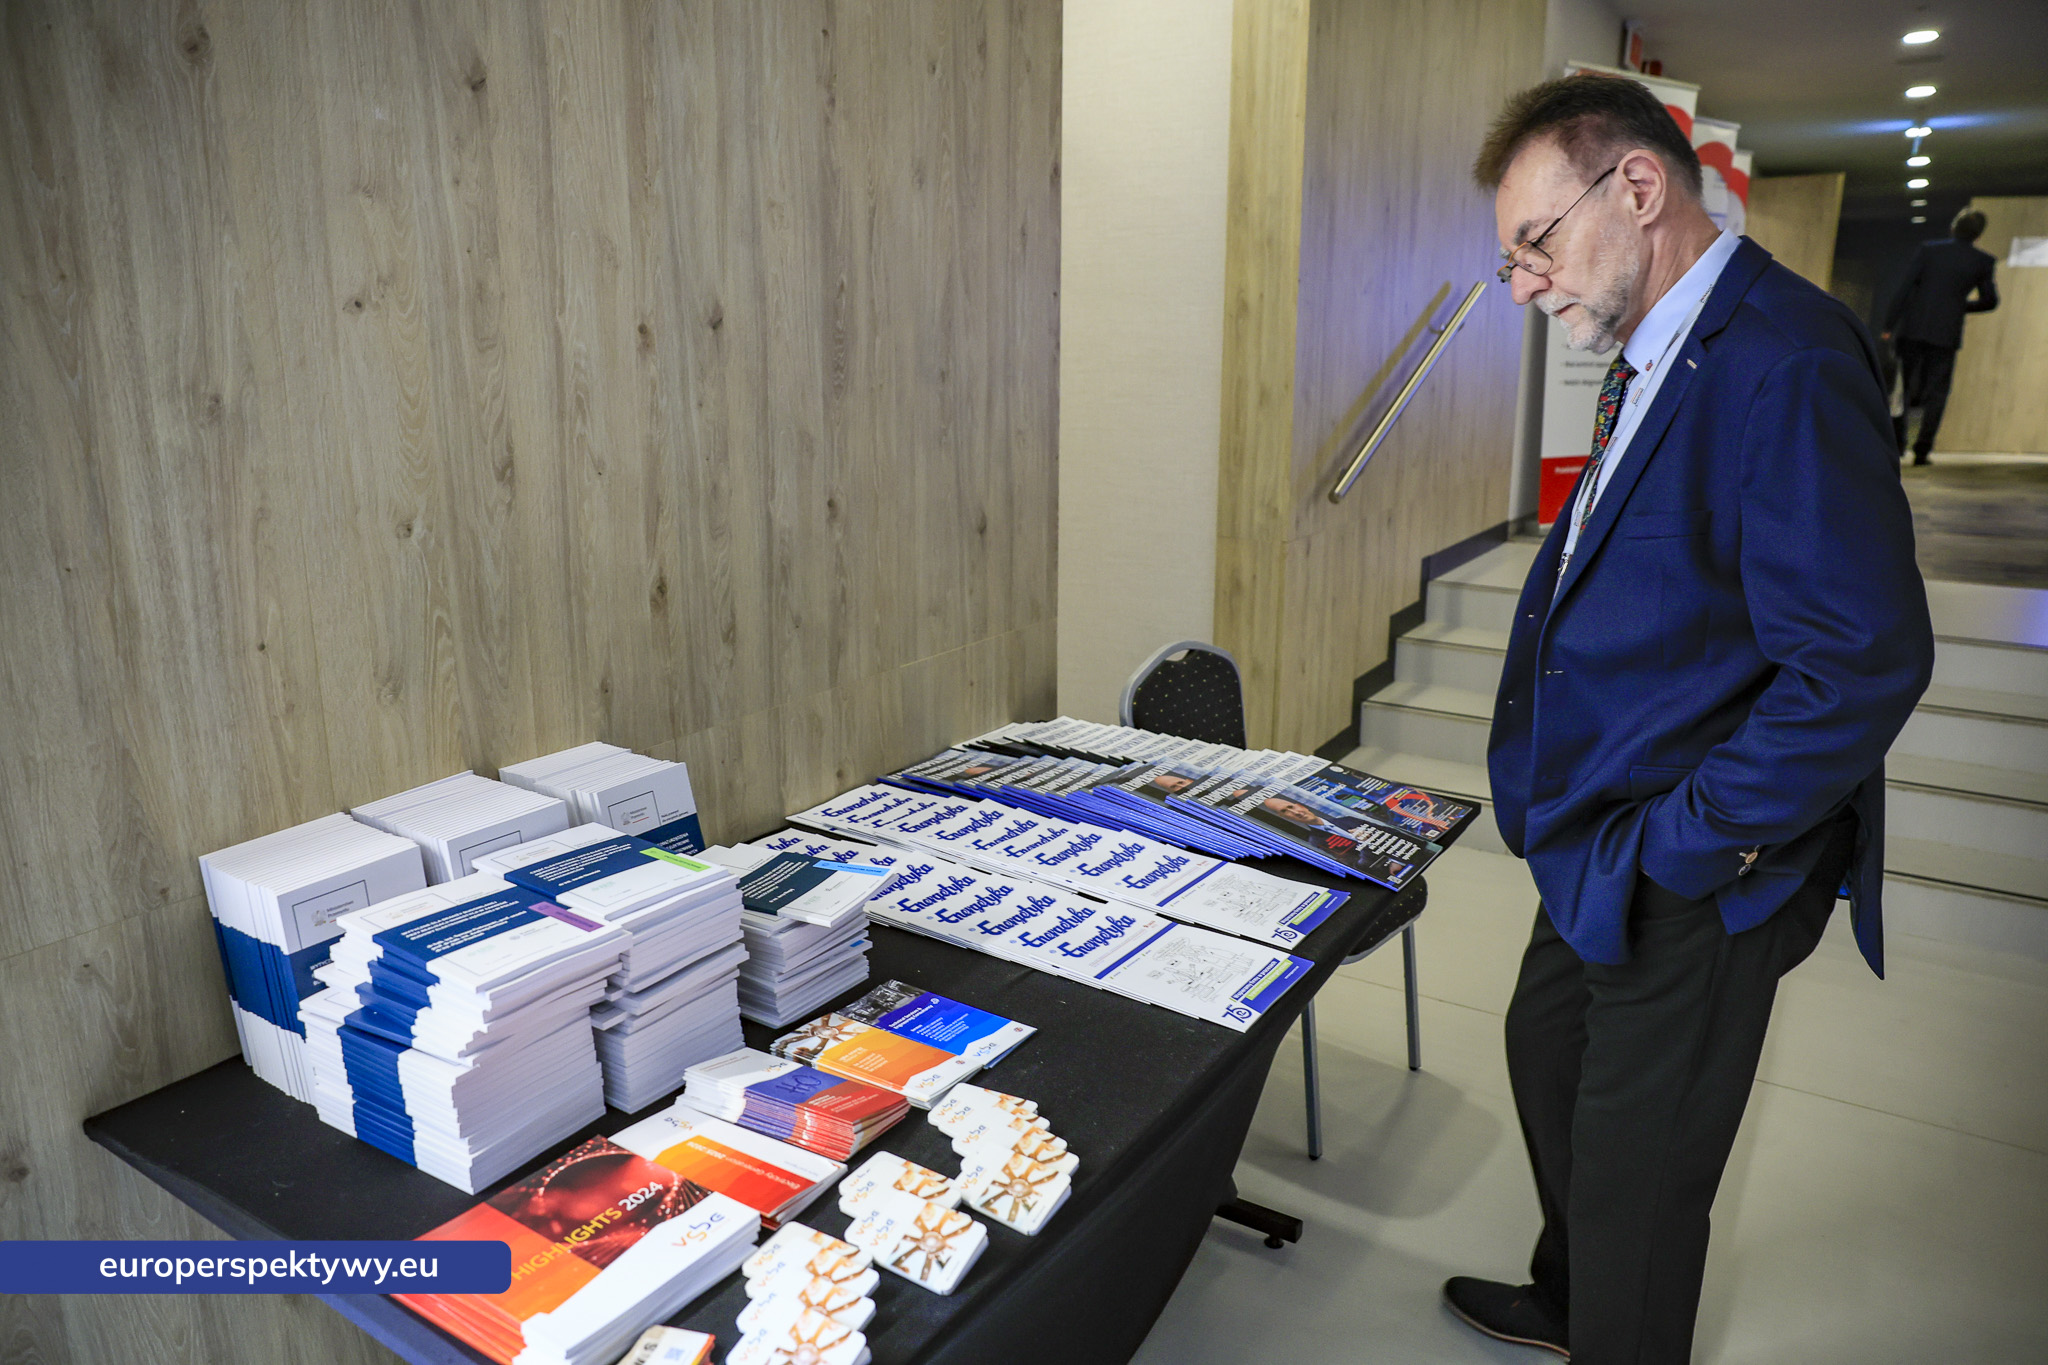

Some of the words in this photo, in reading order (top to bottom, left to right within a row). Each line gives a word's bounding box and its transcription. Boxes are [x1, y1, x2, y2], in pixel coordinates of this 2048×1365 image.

[935, 810, 1005, 841] Energetyka
[1034, 833, 1103, 866] Energetyka
[1076, 843, 1146, 876] Energetyka
[1121, 855, 1191, 889] Energetyka
[897, 875, 977, 913] Energetyka
[934, 885, 1014, 924] Energetyka
[976, 895, 1056, 936] Energetyka
[1017, 907, 1096, 948] Energetyka
[1057, 915, 1137, 958] Energetyka
[1271, 927, 1298, 943] 75
[1222, 1004, 1253, 1023] 75
[511, 1207, 623, 1282] HIGHLIGHTS
[618, 1181, 664, 1213] 2024
[671, 1211, 727, 1248] vgbe
